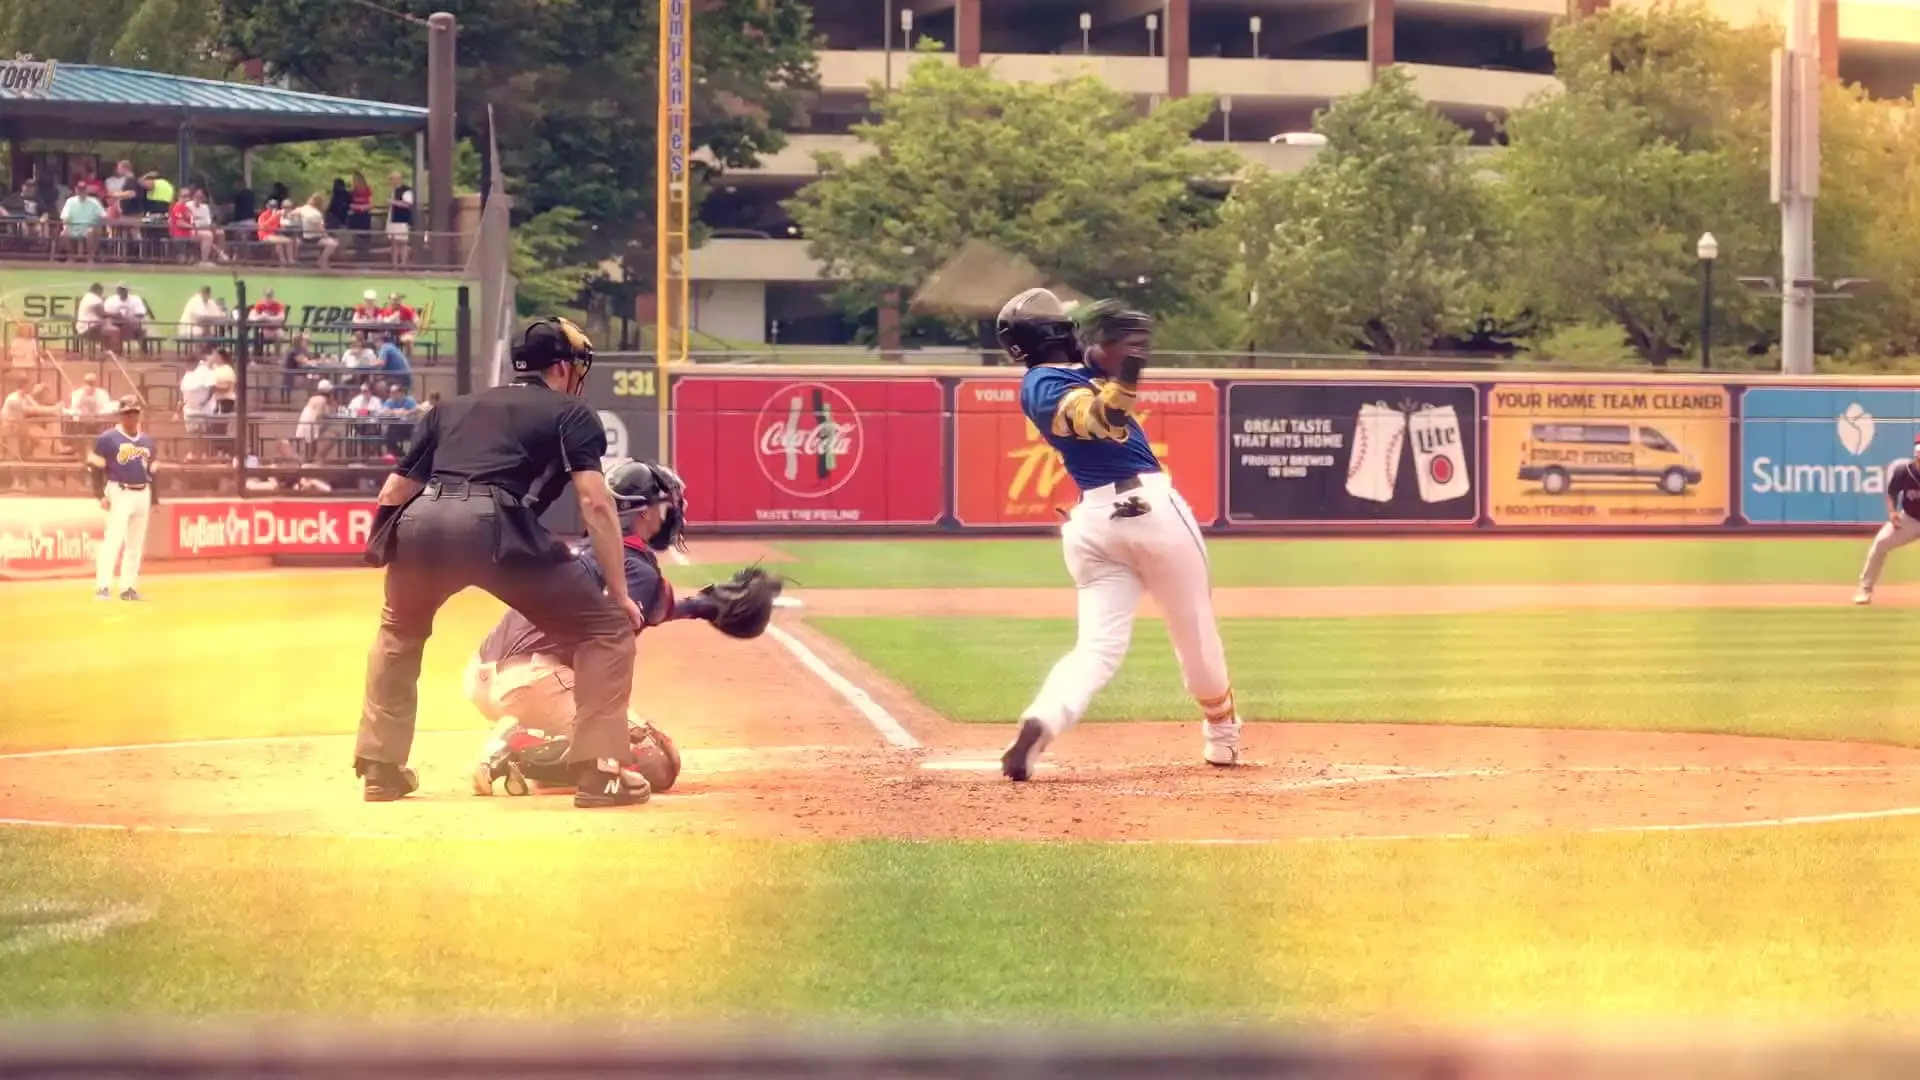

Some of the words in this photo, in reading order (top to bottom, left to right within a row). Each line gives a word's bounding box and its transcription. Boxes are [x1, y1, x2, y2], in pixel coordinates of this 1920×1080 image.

[613, 370, 655, 395] 331
[974, 388, 1014, 401] YOUR
[1496, 393, 1541, 408] YOUR
[1546, 393, 1597, 409] HOME
[1602, 394, 1648, 410] TEAM
[1653, 394, 1723, 410] CLEANER
[1244, 419, 1287, 433] GREAT
[1290, 419, 1332, 433] TASTE
[1233, 433, 1268, 448] THAT
[1269, 433, 1302, 448] HITS
[1303, 433, 1343, 448] HOME
[1417, 426, 1457, 453] Lite
[1241, 455, 1288, 466] PROUDLY
[1289, 455, 1334, 466] BREWED
[755, 509, 790, 520] TASTE
[791, 509, 812, 520] THE
[179, 514, 226, 554] KeyBank
[254, 510, 340, 544] Duck
